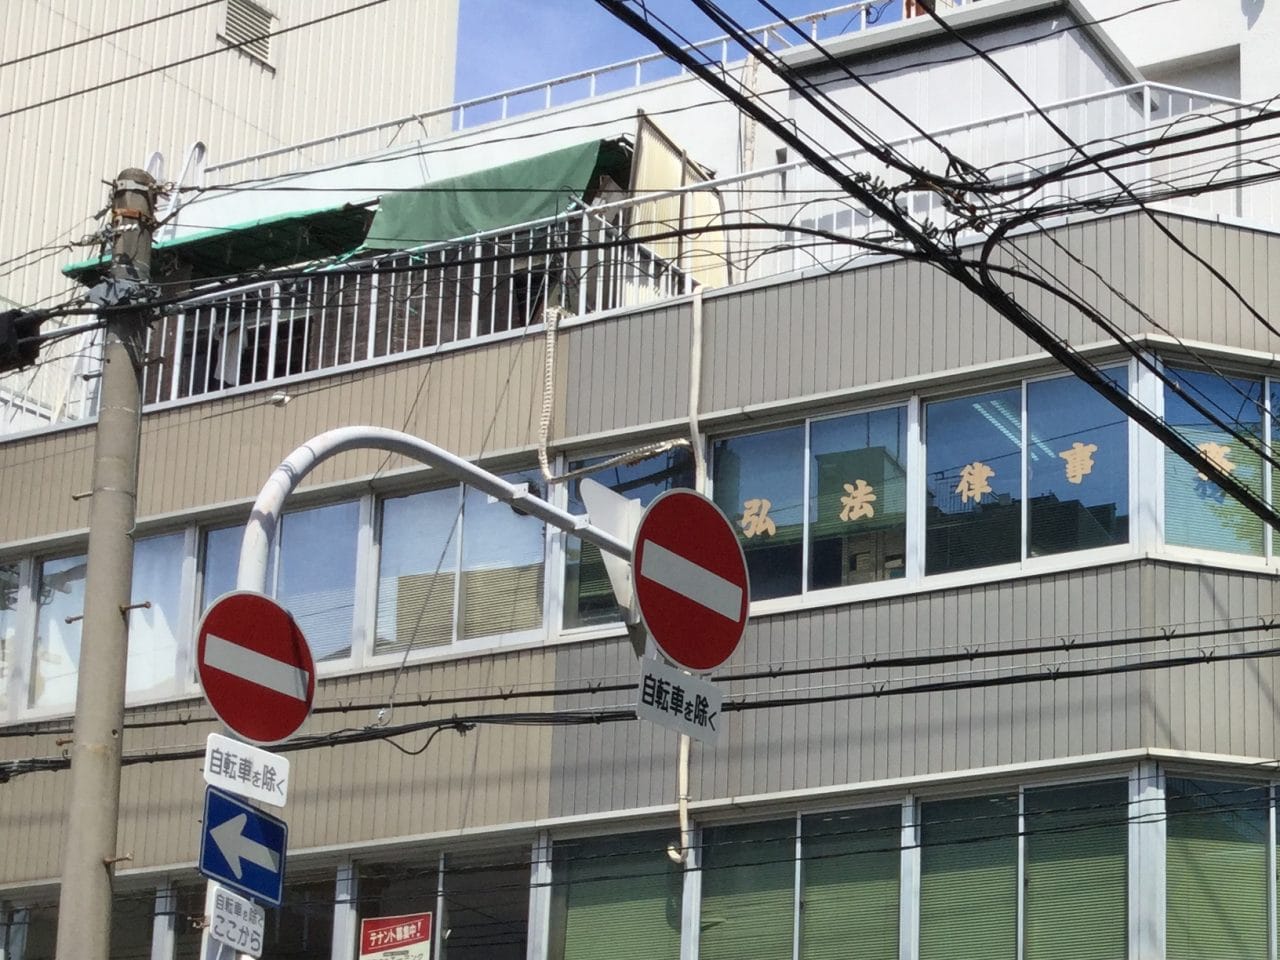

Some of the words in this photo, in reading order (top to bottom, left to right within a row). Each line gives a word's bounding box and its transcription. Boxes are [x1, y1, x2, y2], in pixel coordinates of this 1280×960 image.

[641, 673, 717, 731] 自転車を除く
[209, 747, 286, 796] 自転車を除く
[213, 914, 262, 952] ここから
